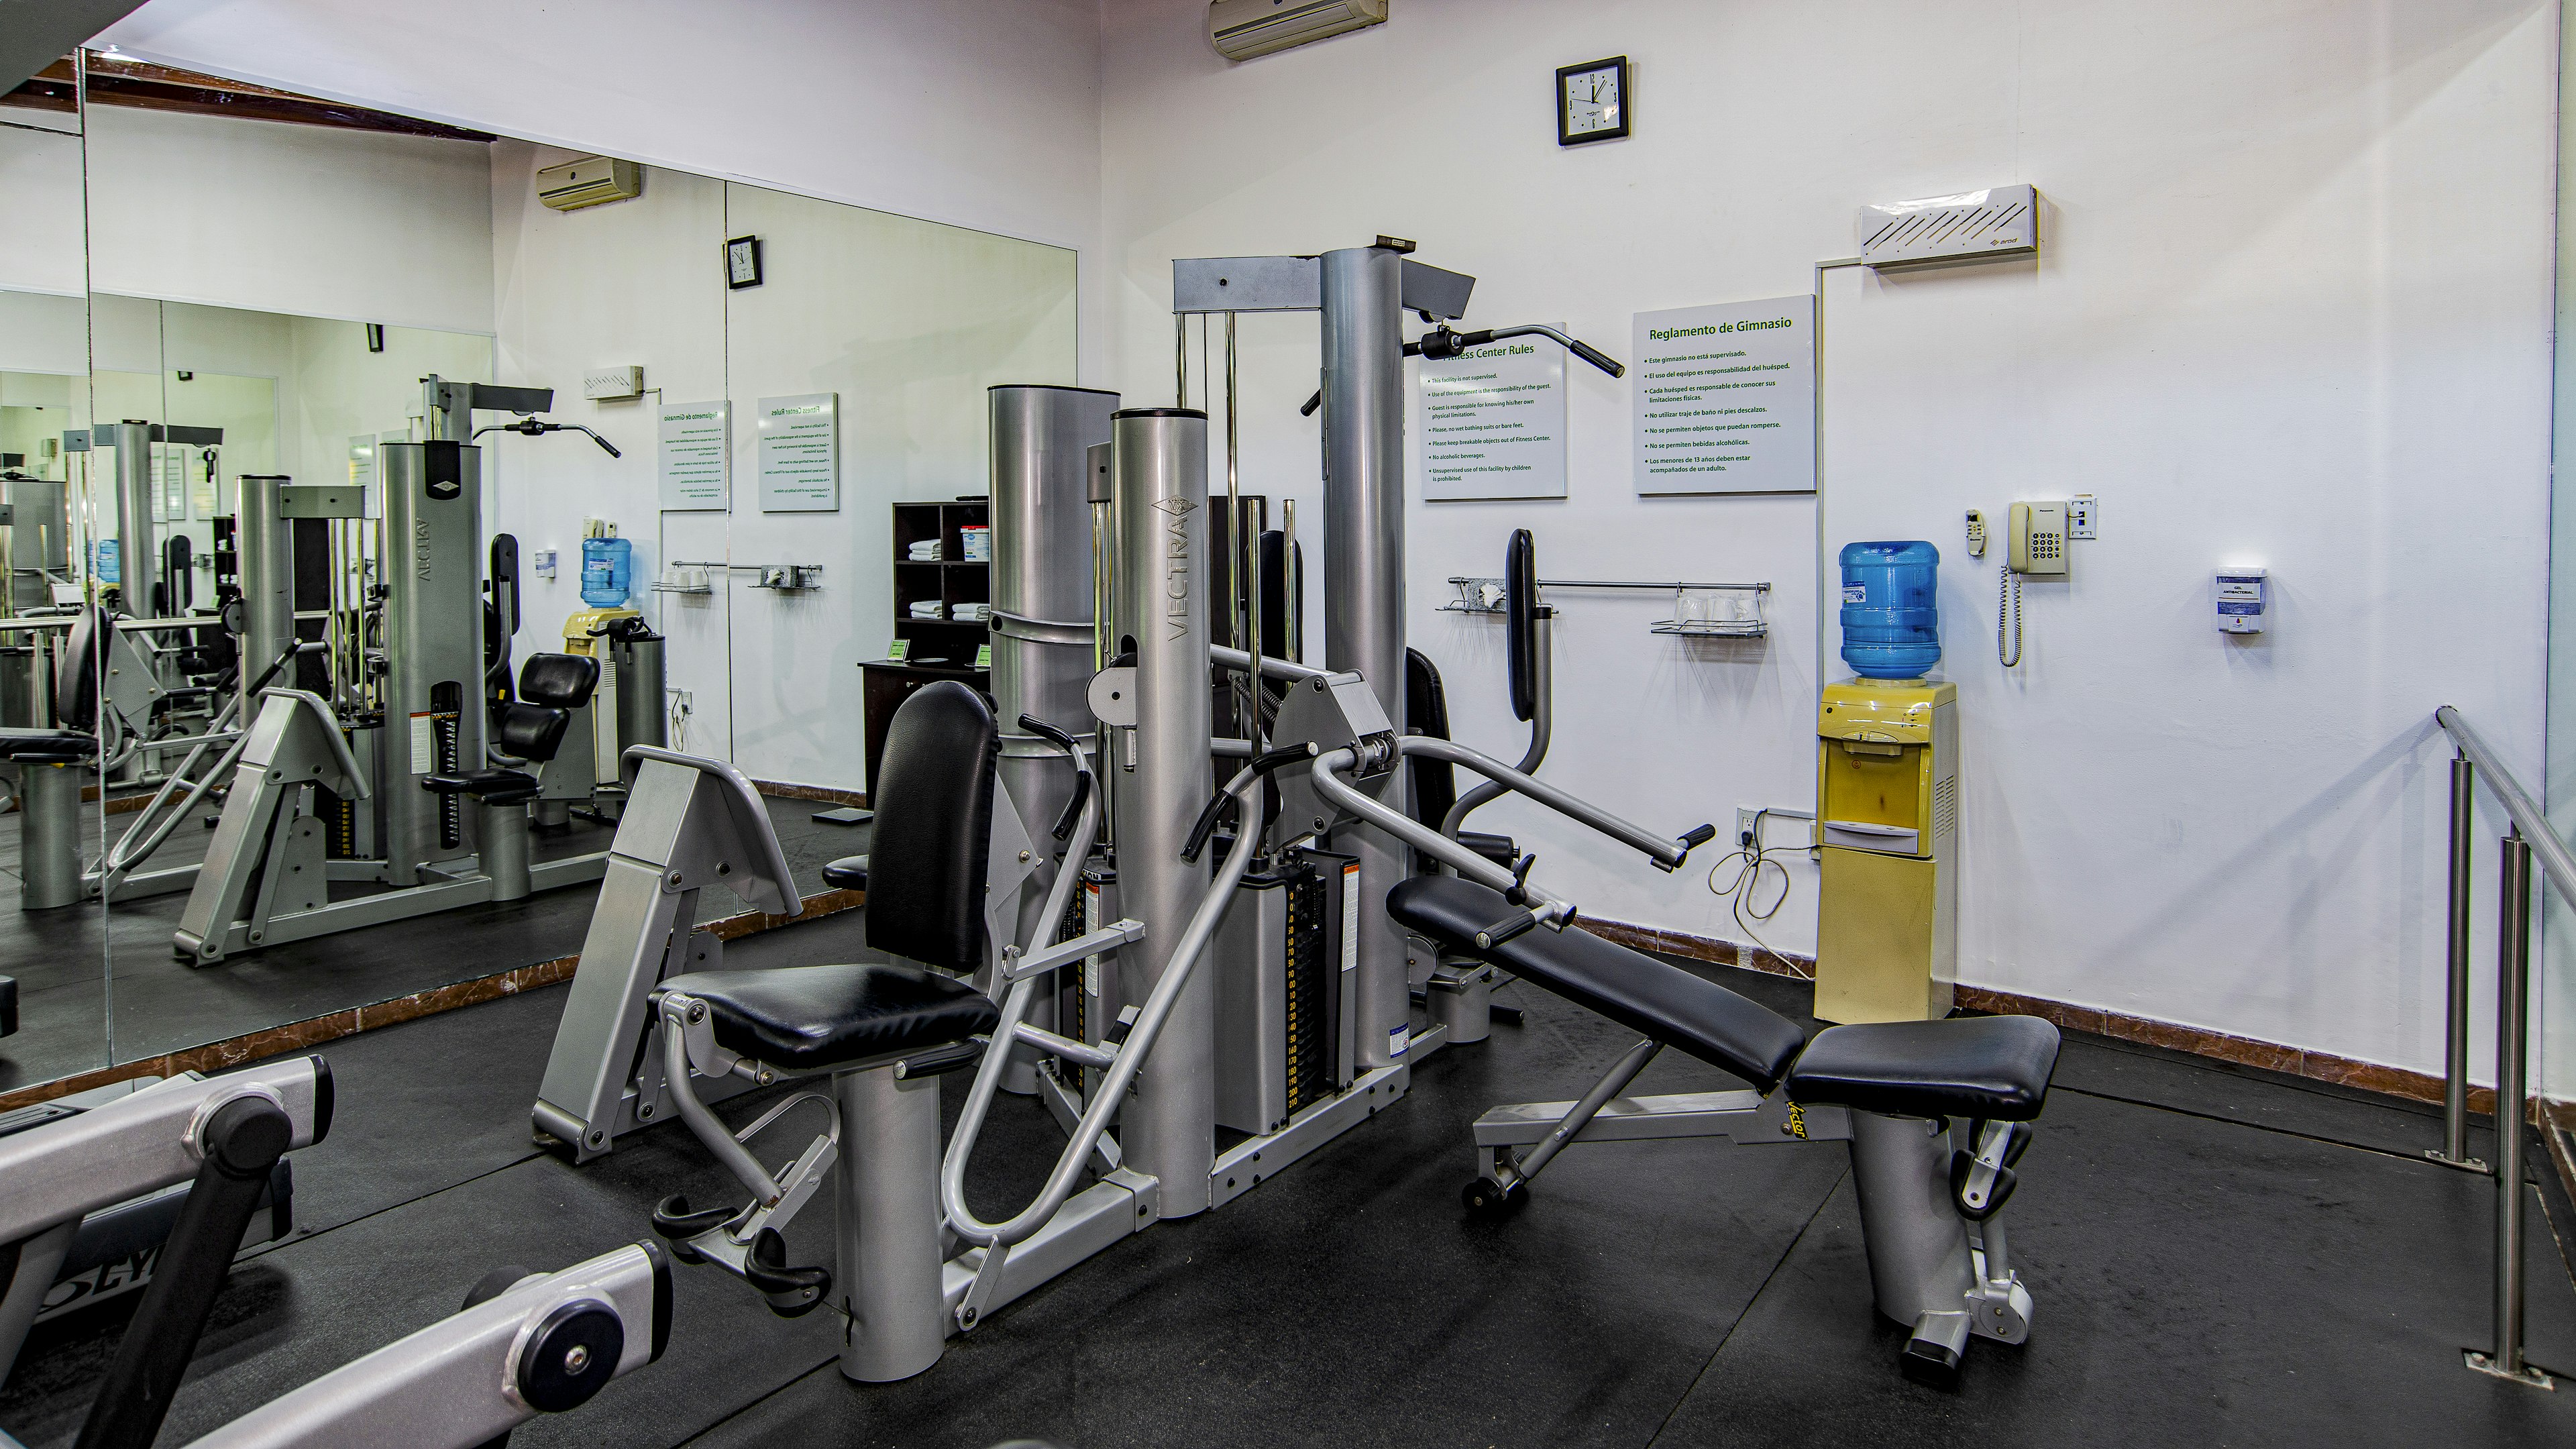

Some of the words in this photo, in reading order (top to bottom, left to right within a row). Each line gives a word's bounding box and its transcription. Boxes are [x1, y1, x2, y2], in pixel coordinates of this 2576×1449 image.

[1590, 74, 1595, 84] 12
[1613, 92, 1617, 103] 3
[1569, 100, 1572, 110] 9
[1592, 119, 1595, 129] 6
[1650, 325, 1716, 341] Reglamento
[1719, 322, 1733, 333] de
[1736, 317, 1792, 331] Gimnasio
[1476, 347, 1507, 358] Center
[1509, 344, 1534, 355] Rules
[1661, 355, 1686, 364] gimnasio
[1709, 350, 1746, 360] supervisado.
[1676, 370, 1697, 378] equipo
[1705, 365, 1751, 376] responsabilidad
[1762, 362, 1790, 370] huésped.
[1470, 372, 1497, 381] supervised.
[1491, 385, 1521, 393] responsibility
[1696, 382, 1731, 392] responsable
[1678, 410, 1692, 418] traje
[1666, 426, 1691, 434] permiten
[1692, 425, 1714, 433] objetos
[1727, 423, 1750, 431] puedan
[1666, 441, 1691, 449] permiten
[1650, 466, 1688, 474] acompañados
[1167, 515, 1189, 642] VECTRA
[1289, 1044, 1297, 1055] 160
[1289, 1055, 1297, 1065] 170
[1289, 1065, 1297, 1075] 180
[1289, 1076, 1297, 1086] 190
[1289, 1086, 1297, 1097] 200
[1289, 1097, 1297, 1108] 210
